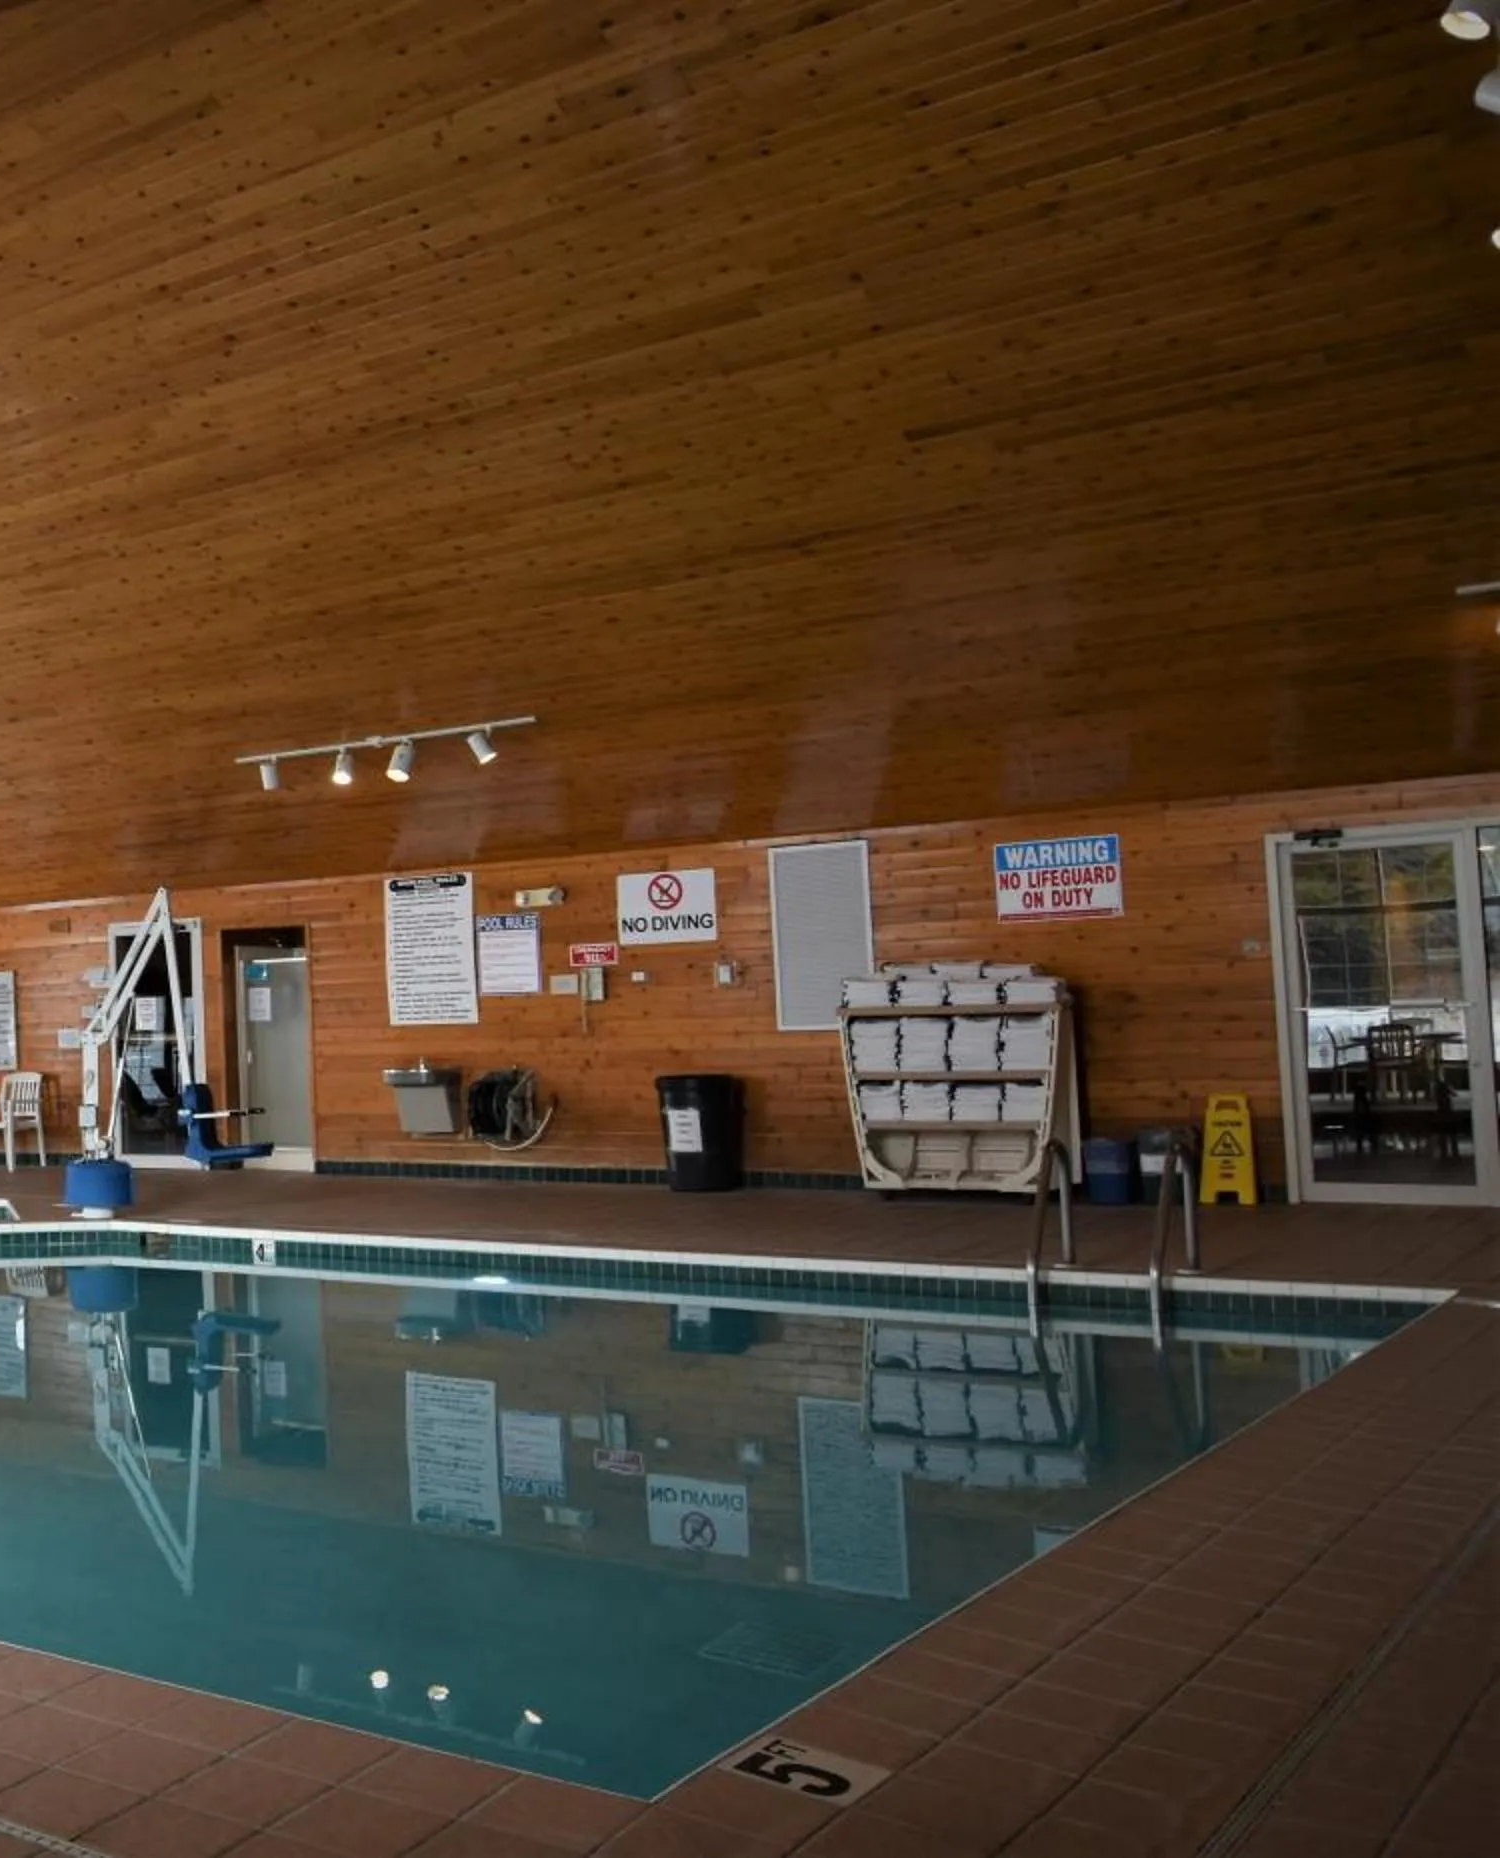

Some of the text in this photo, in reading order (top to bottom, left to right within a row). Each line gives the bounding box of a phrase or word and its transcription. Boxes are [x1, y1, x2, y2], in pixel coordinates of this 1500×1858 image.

[1004, 840, 1109, 869] WARNING
[1000, 865, 1117, 890] NO LIFEGUARD
[1022, 888, 1093, 910] ON DUTY
[477, 917, 504, 932] POOL
[622, 913, 714, 933] NO DIVING
[733, 1751, 851, 1797] 5
